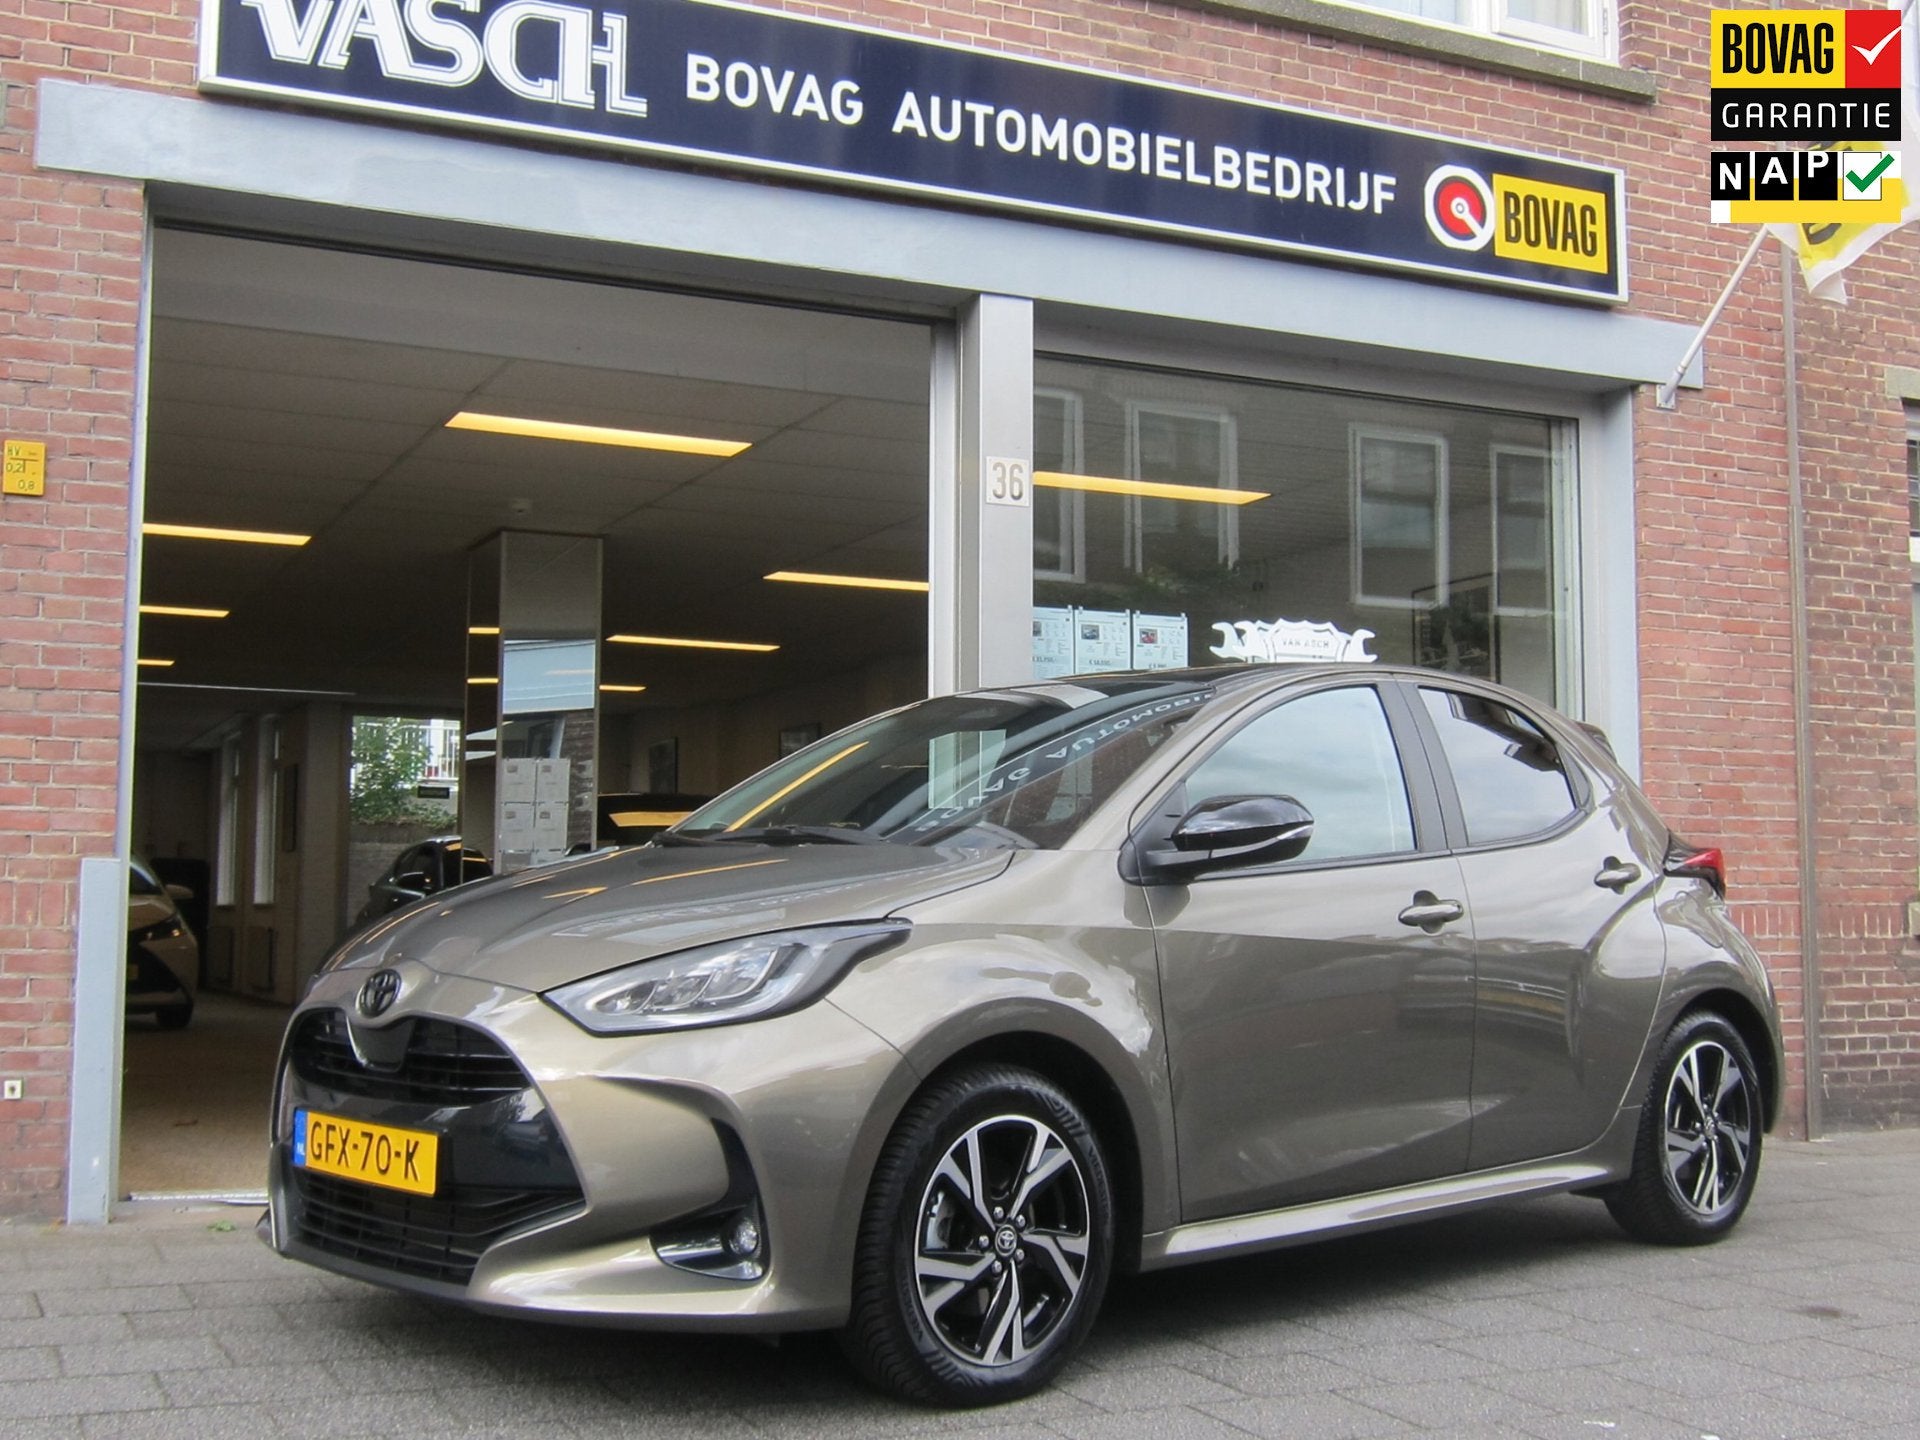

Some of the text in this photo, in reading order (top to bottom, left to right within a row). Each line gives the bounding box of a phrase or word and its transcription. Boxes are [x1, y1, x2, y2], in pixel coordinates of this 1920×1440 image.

[685, 53, 1397, 215] BOVAG AUTOMOBIELBEDRIJF
[1503, 190, 1599, 258] BOVAG
[992, 462, 1023, 501] 36
[310, 1120, 420, 1183] GFX-70-K
